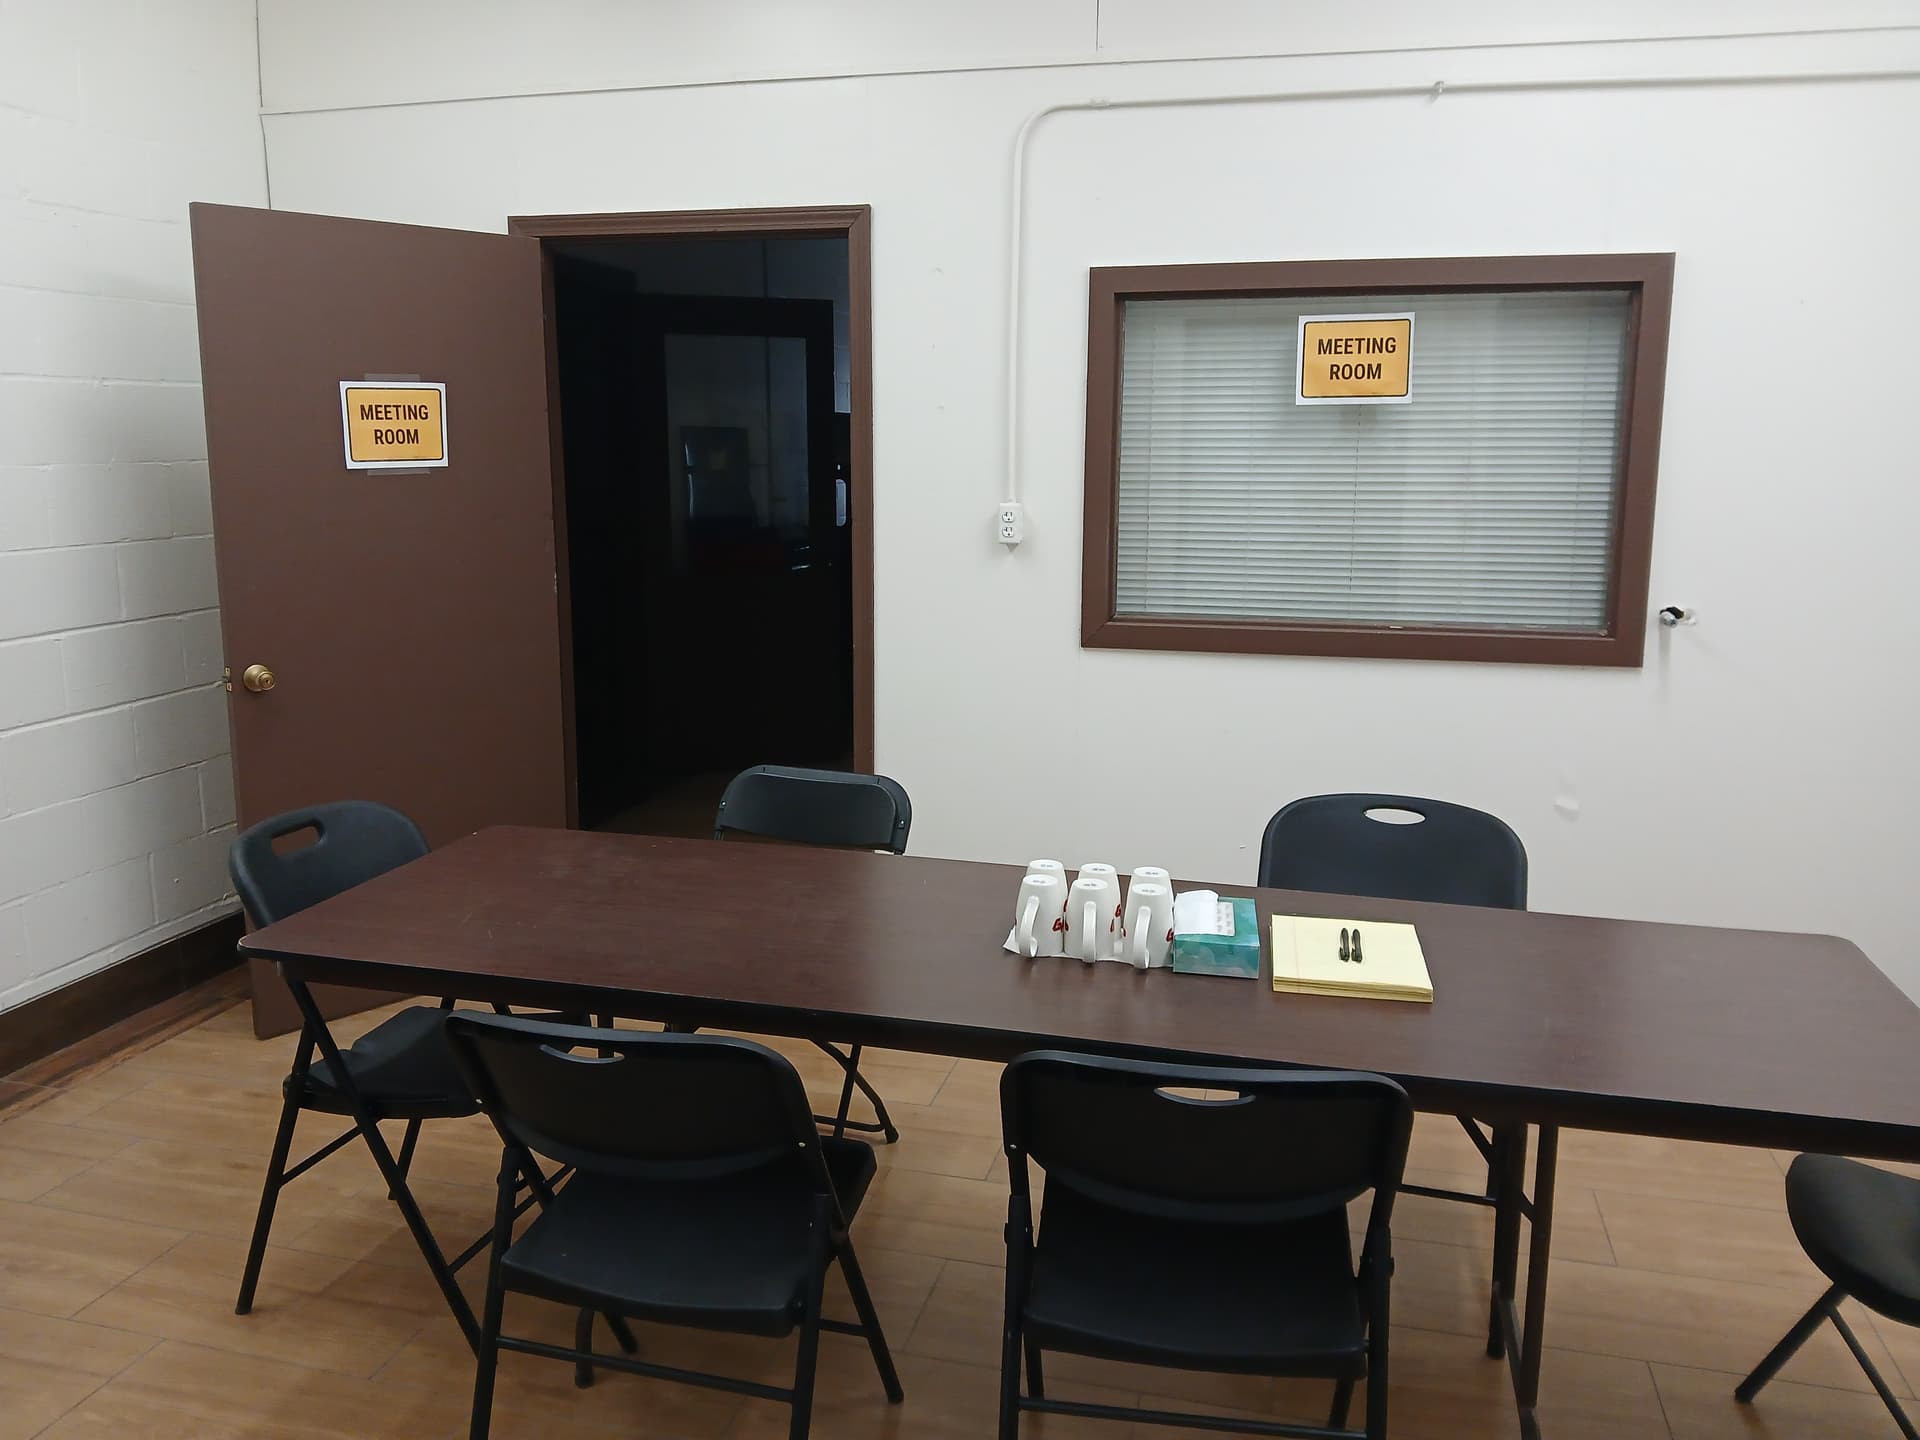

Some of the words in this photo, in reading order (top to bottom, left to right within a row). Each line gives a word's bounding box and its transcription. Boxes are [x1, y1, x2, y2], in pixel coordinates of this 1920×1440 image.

[1317, 337, 1396, 355] MEETING
[1329, 363, 1382, 380] ROOM
[360, 404, 429, 420] MEETING
[374, 429, 419, 445] ROOM
